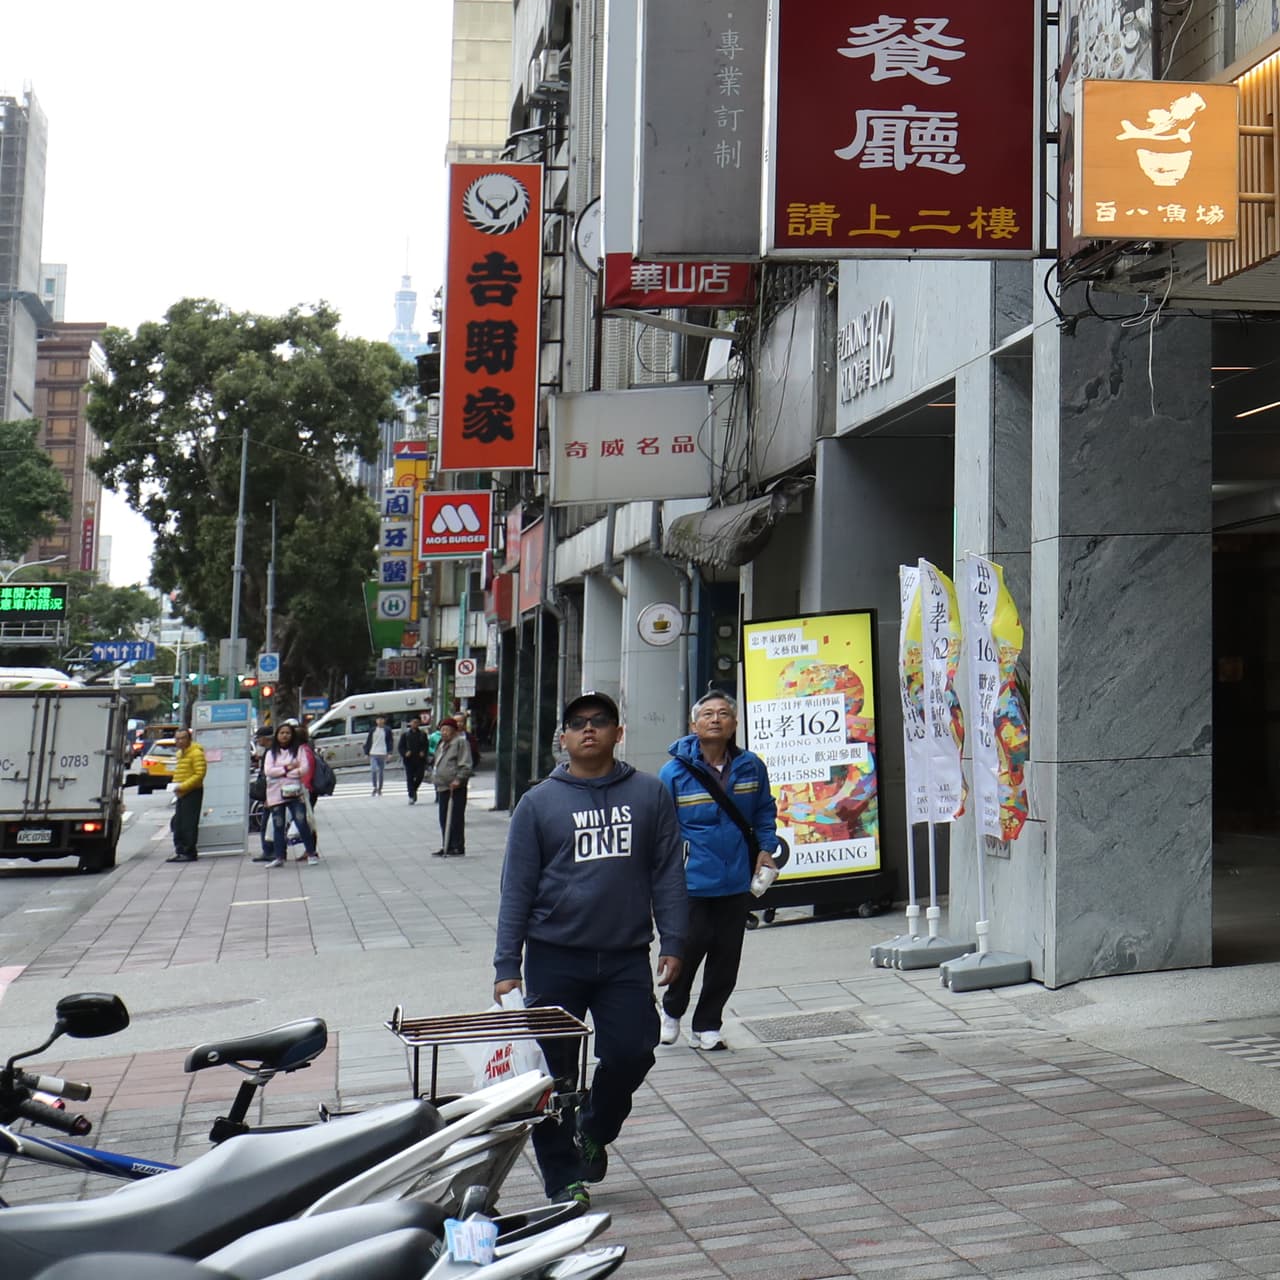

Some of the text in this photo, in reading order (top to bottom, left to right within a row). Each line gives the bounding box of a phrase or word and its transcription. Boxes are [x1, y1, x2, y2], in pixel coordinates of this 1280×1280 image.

[833, 13, 967, 176] 餐廳
[786, 200, 1020, 240] 請上二樓
[1095, 200, 1225, 225] 百八魚場
[630, 263, 732, 295] 華山店
[868, 295, 896, 387] 162
[565, 434, 696, 459] 奇威名品
[425, 535, 486, 545] MOS BURGER
[753, 709, 841, 740] 忠孝162
[753, 735, 842, 751] ART ZHONG XIAO
[0, 754, 89, 771] C- 0783
[768, 768, 825, 783] 2341-5888
[572, 805, 632, 829] WIN AS
[576, 828, 630, 858] ONE
[795, 845, 868, 867] PARKING
